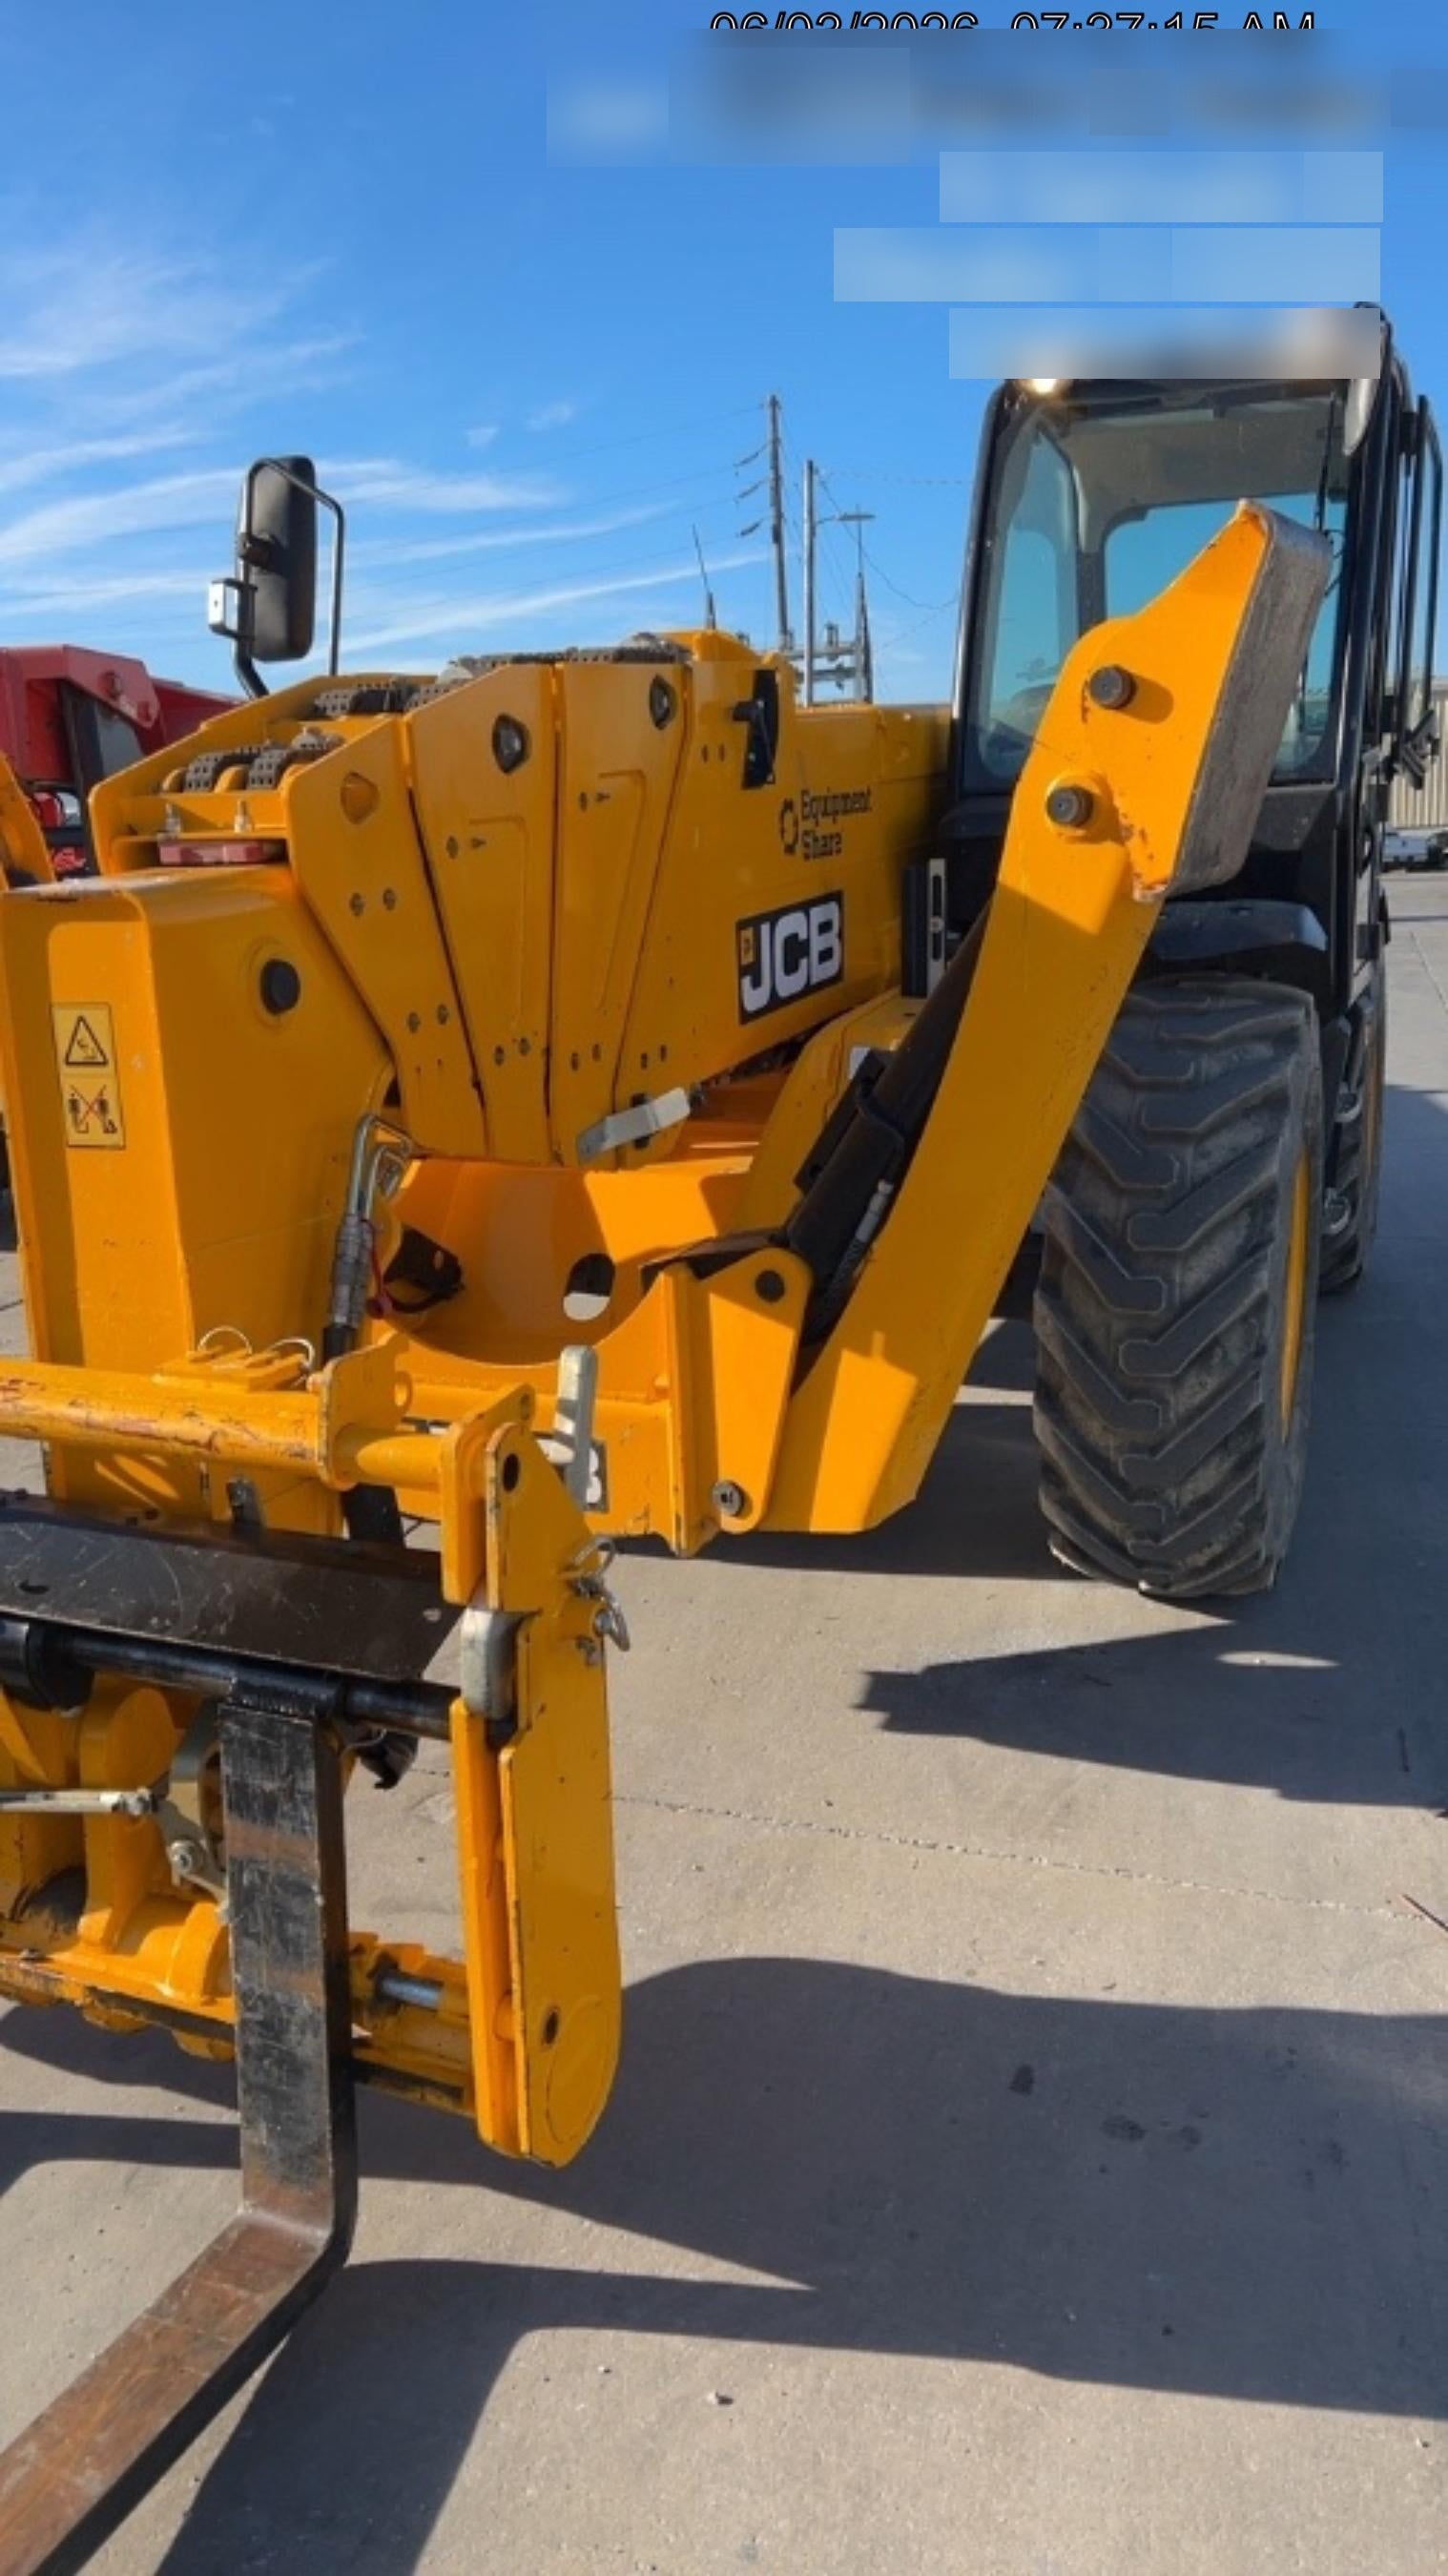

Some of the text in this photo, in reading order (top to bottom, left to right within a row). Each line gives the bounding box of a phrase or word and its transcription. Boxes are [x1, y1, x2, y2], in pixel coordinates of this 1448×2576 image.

[801, 785, 872, 826] Equipment
[803, 830, 842, 862] Share
[741, 901, 840, 1013] JCB
